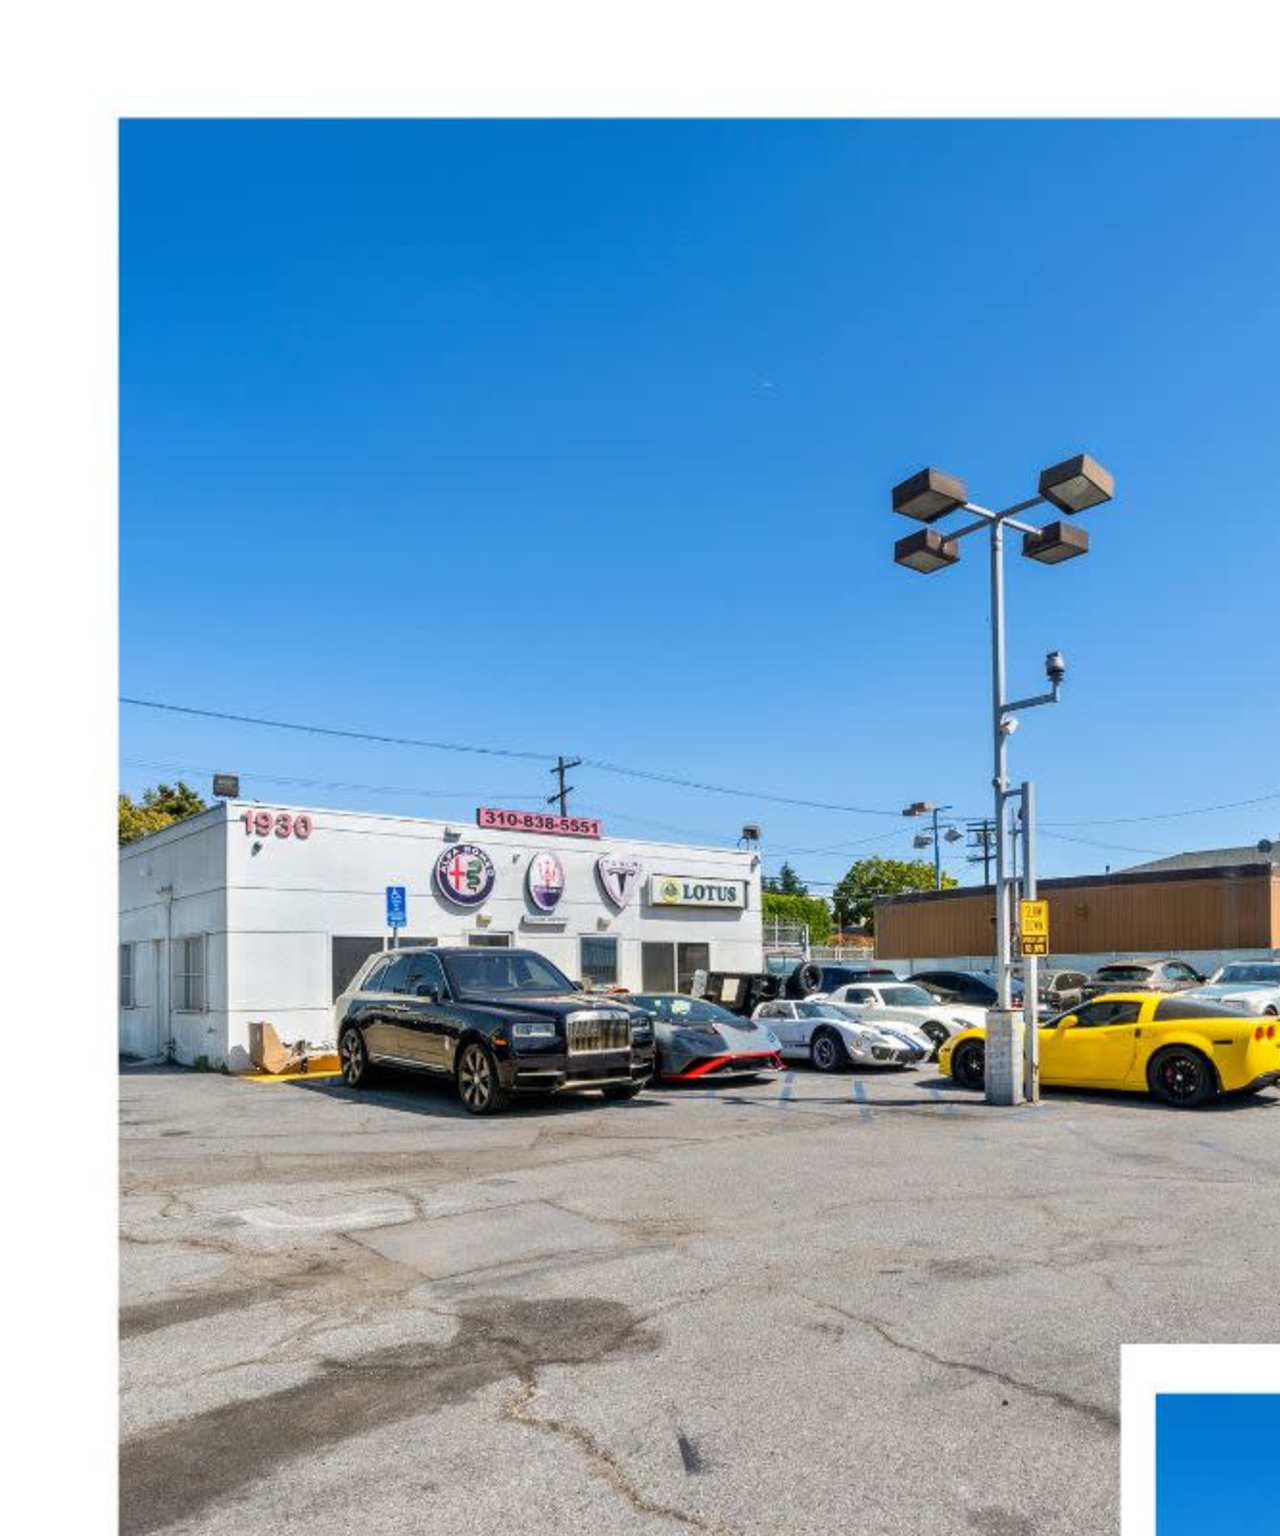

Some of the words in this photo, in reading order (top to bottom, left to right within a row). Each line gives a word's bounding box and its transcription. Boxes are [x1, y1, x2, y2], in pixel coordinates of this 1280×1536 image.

[241, 810, 312, 838] 1930
[485, 811, 599, 834] 310-838-5551
[683, 884, 736, 902] LOTUS
